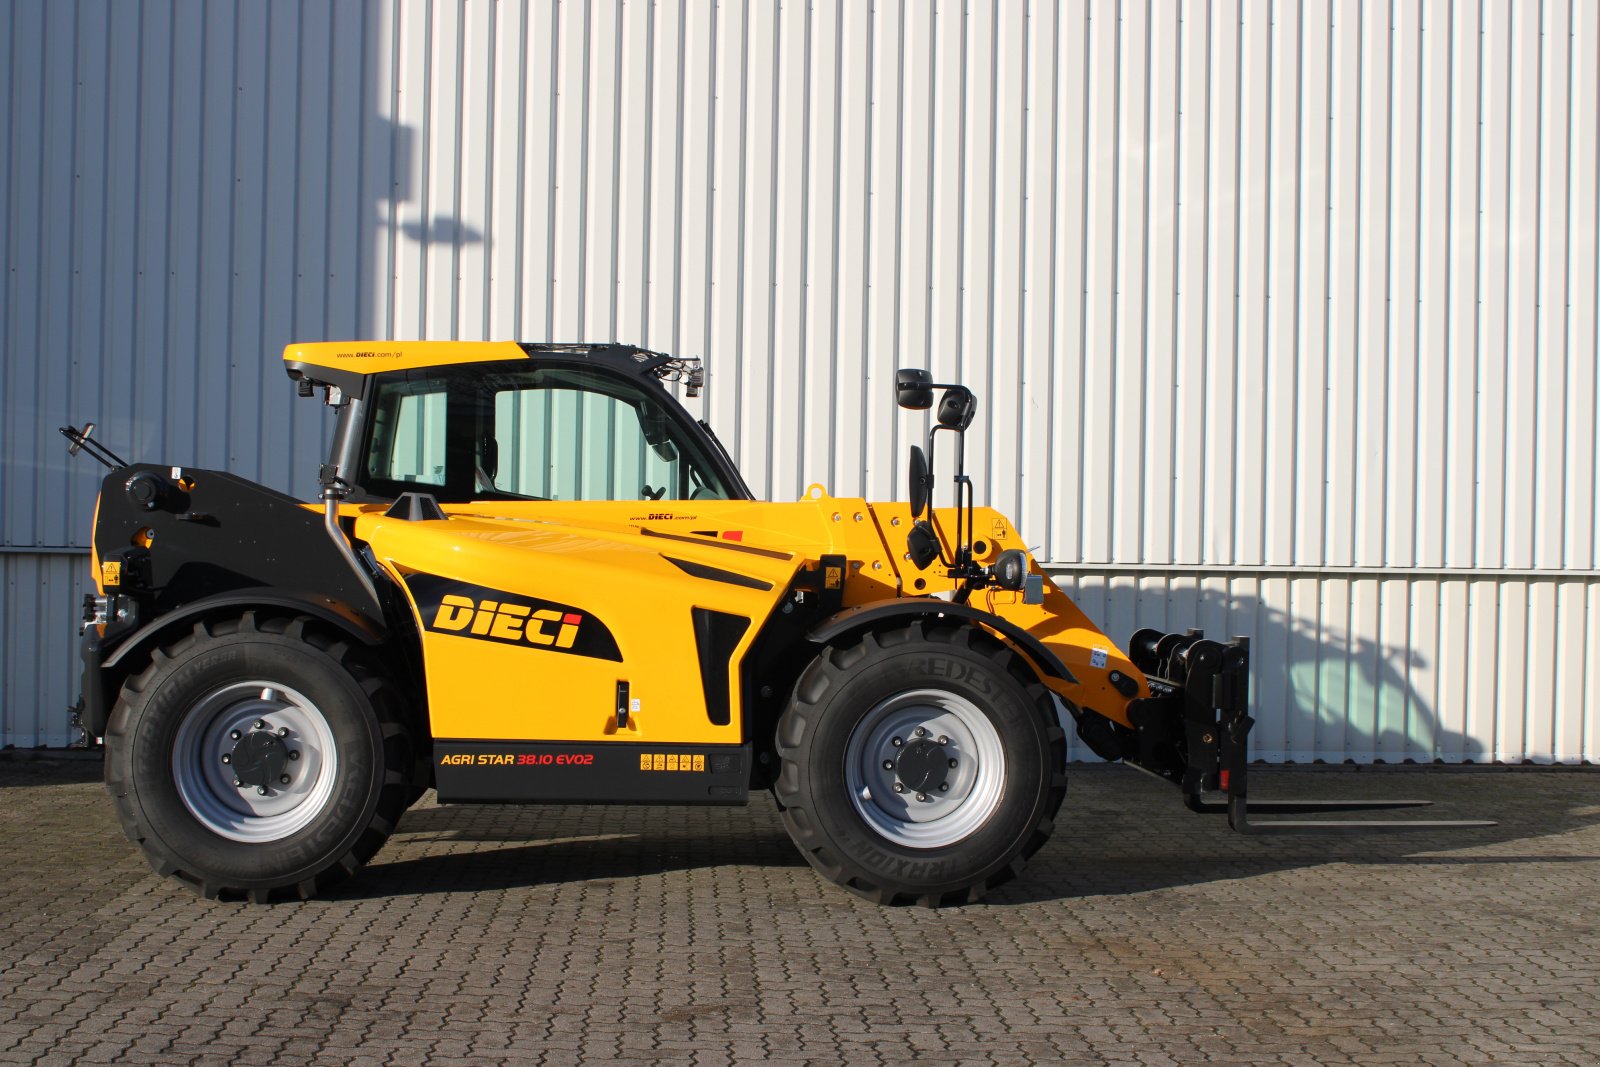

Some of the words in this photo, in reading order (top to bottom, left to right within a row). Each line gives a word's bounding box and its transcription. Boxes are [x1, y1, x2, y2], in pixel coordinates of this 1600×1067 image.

[441, 754, 475, 765] AGRI
[478, 754, 514, 765] STAR
[517, 754, 553, 765] 38.10
